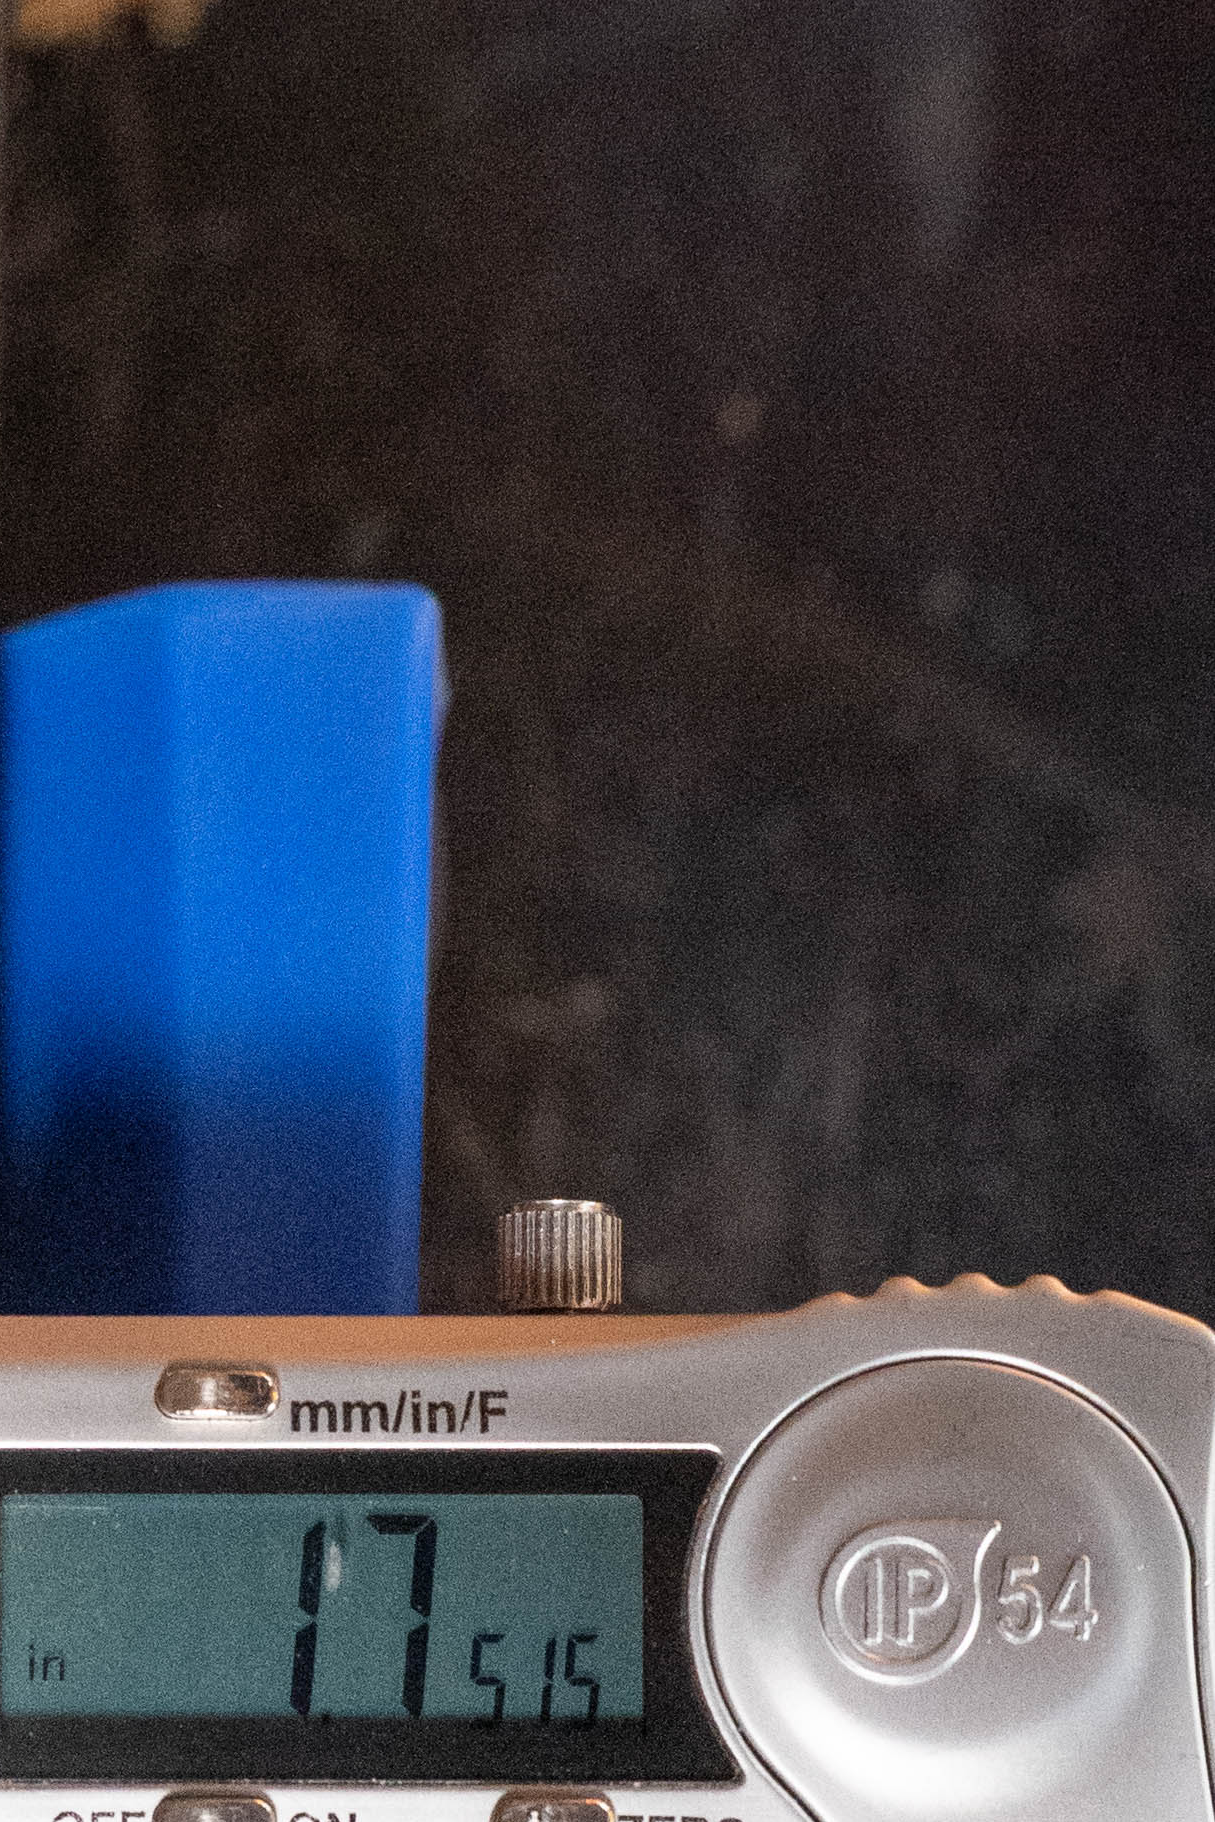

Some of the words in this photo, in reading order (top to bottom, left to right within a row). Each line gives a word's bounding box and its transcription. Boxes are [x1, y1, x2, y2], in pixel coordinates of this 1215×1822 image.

[289, 1390, 509, 1437] mm/in/F
[862, 1554, 949, 1647] IP
[997, 1552, 1099, 1645] 54
[27, 1644, 67, 1682] in
